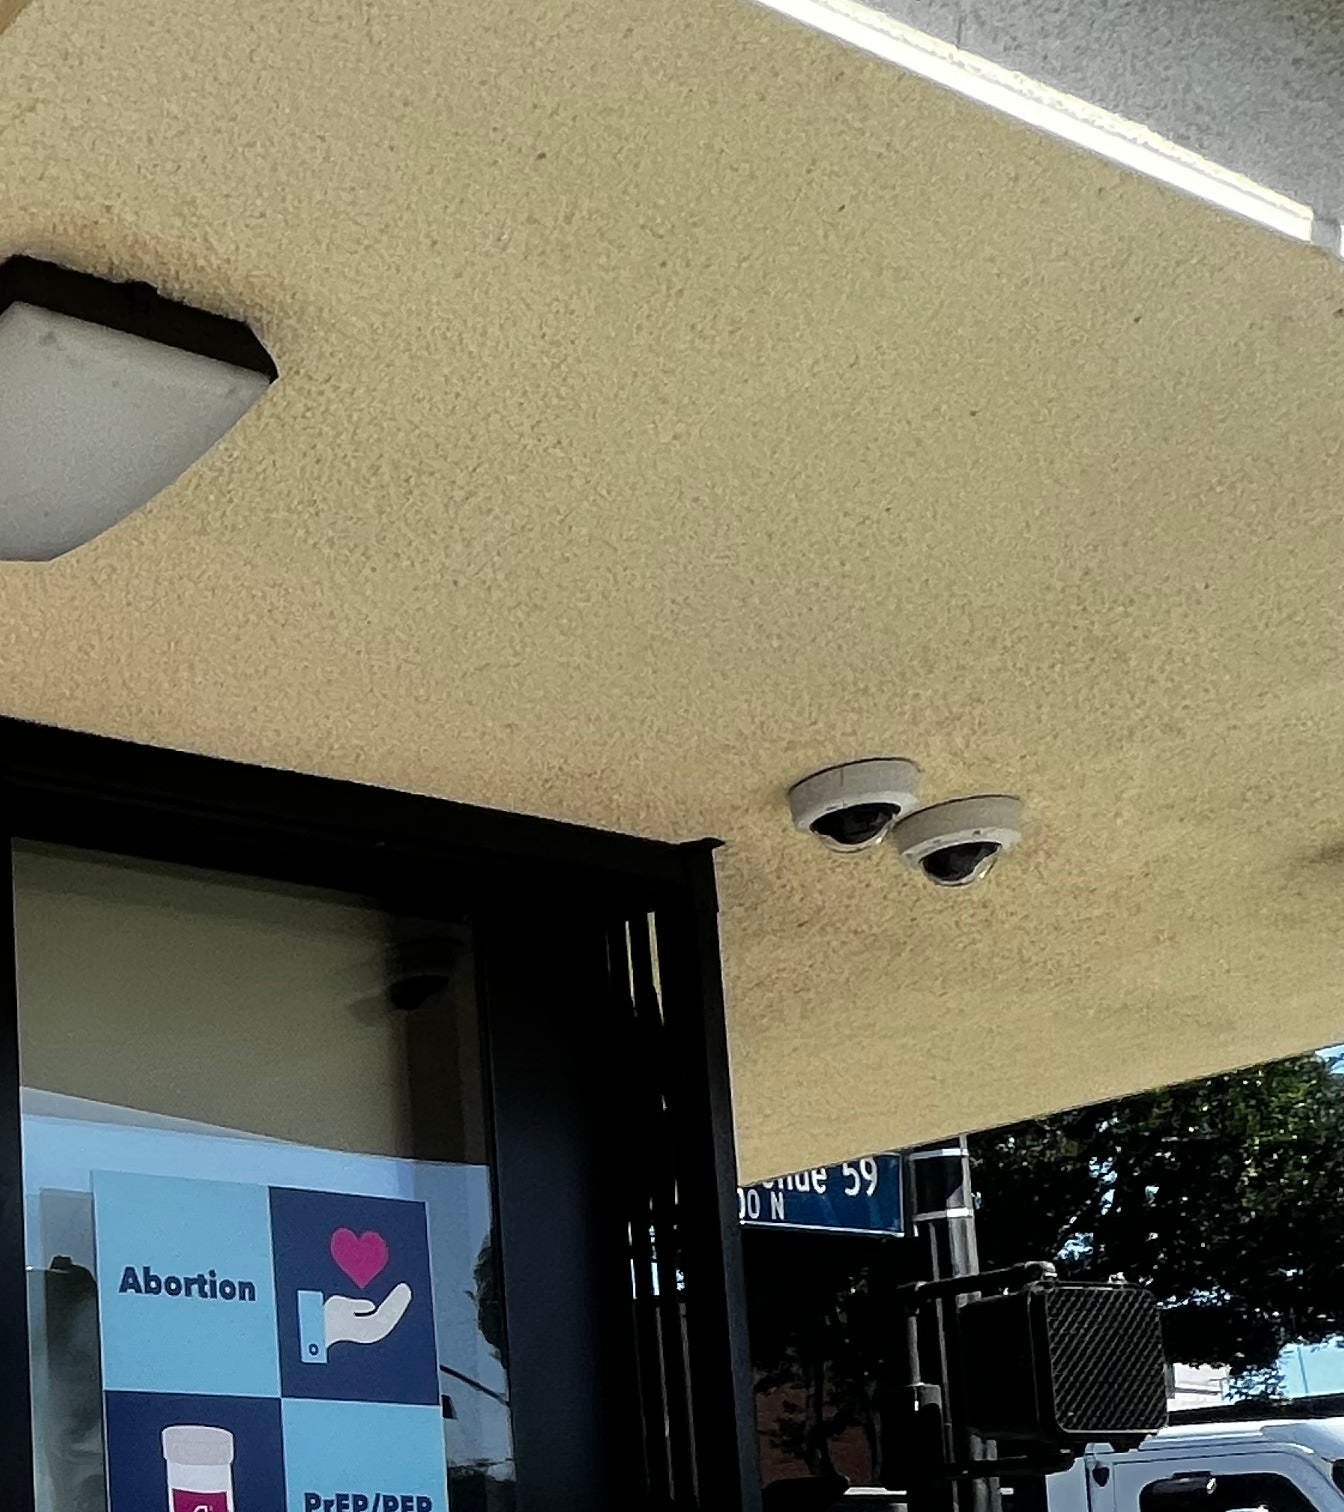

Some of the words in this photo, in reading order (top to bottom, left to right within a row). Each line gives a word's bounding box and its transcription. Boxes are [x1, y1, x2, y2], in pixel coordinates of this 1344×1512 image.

[842, 1157, 877, 1196] 59
[771, 1191, 784, 1220] N
[119, 1266, 256, 1301] Abortion
